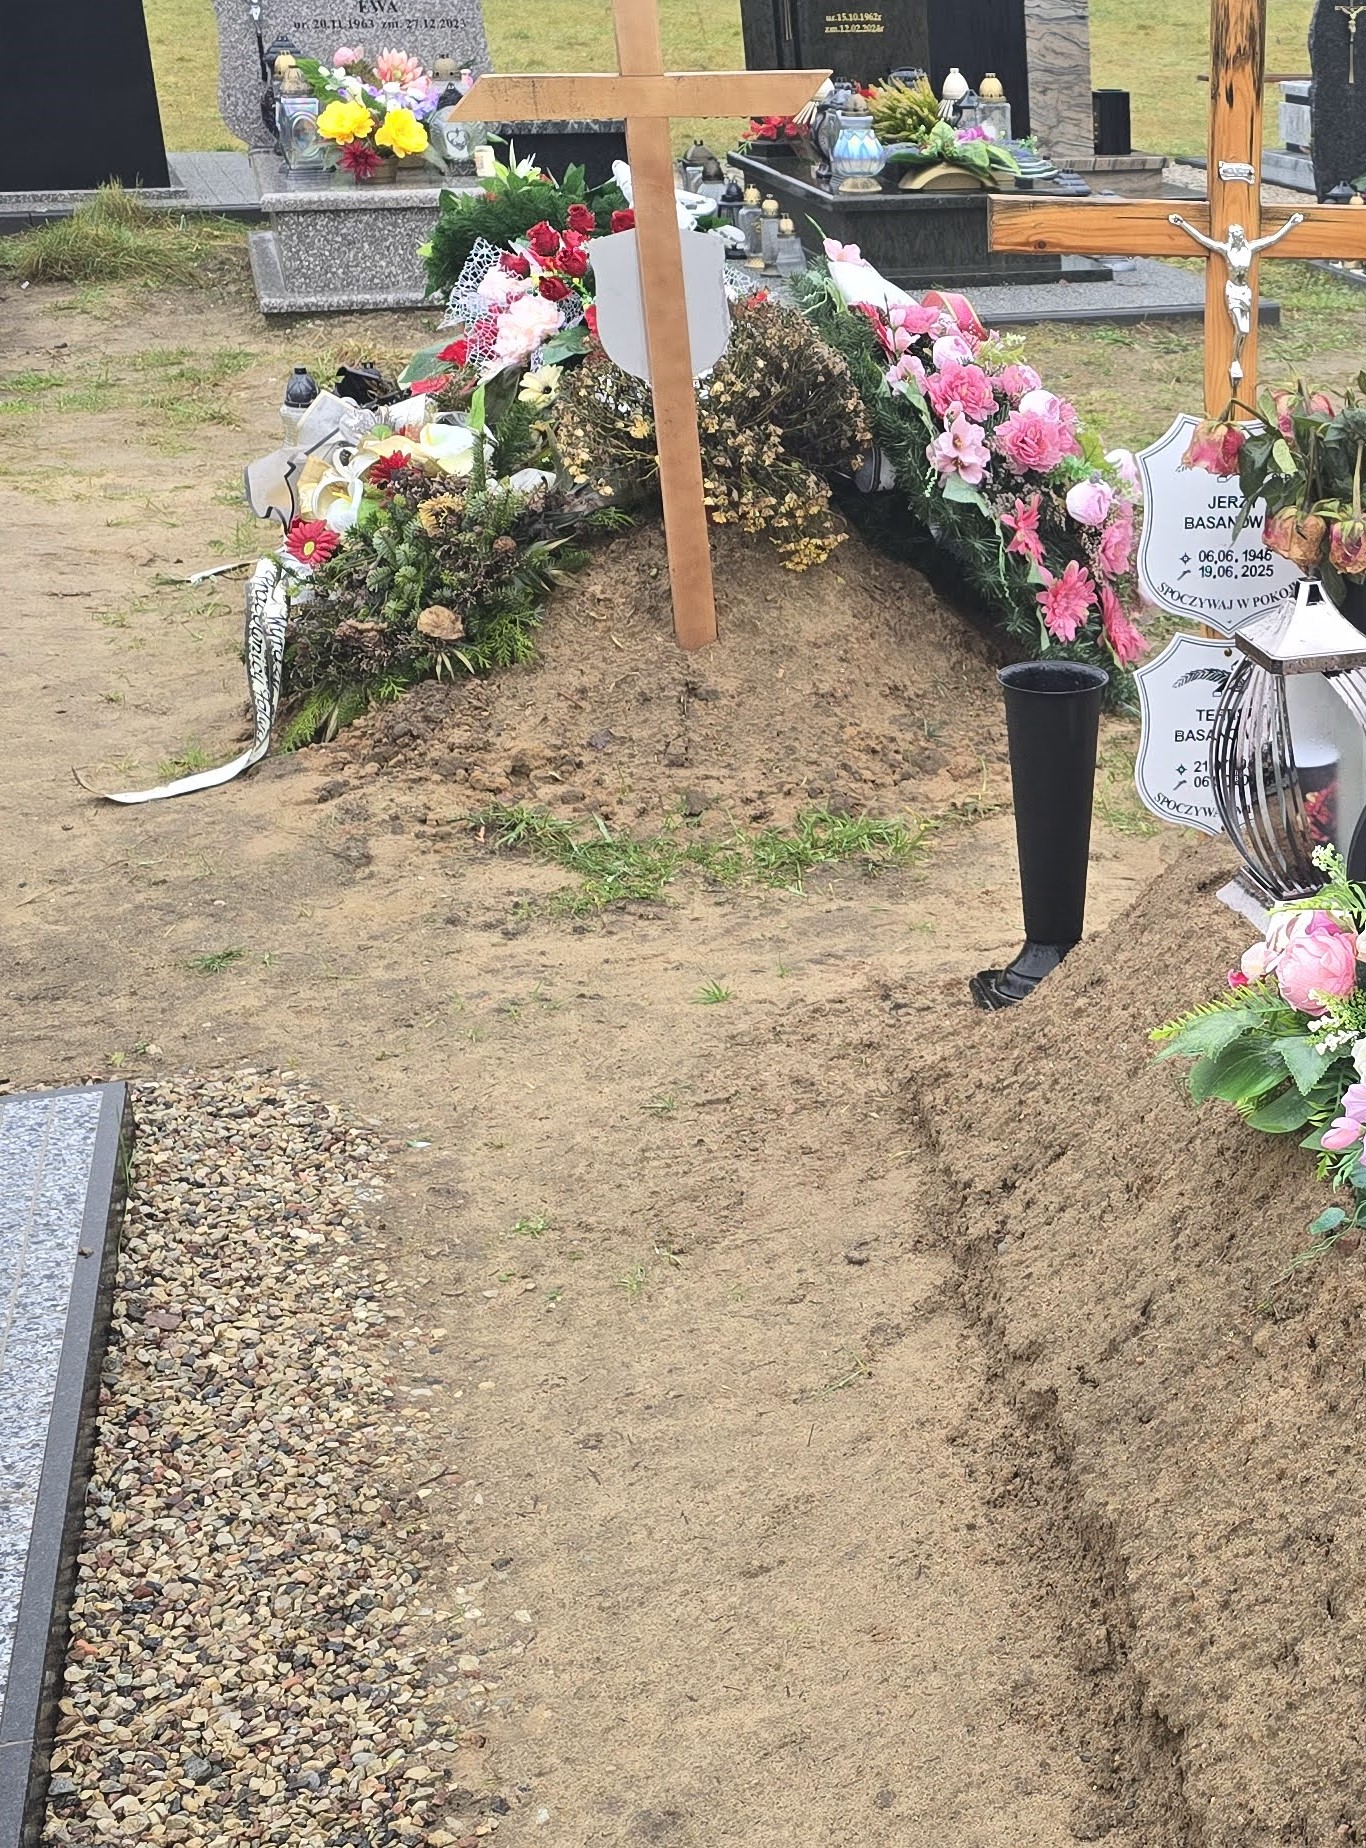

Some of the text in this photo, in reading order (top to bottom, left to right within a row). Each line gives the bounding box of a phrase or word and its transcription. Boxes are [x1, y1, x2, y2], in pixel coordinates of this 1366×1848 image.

[359, 0, 398, 13] EWA
[1242, 549, 1272, 562] 1946
[1241, 564, 1275, 578] 2025
[1157, 582, 1233, 611] SPOCZYWAJ
[1236, 599, 1249, 609] W
